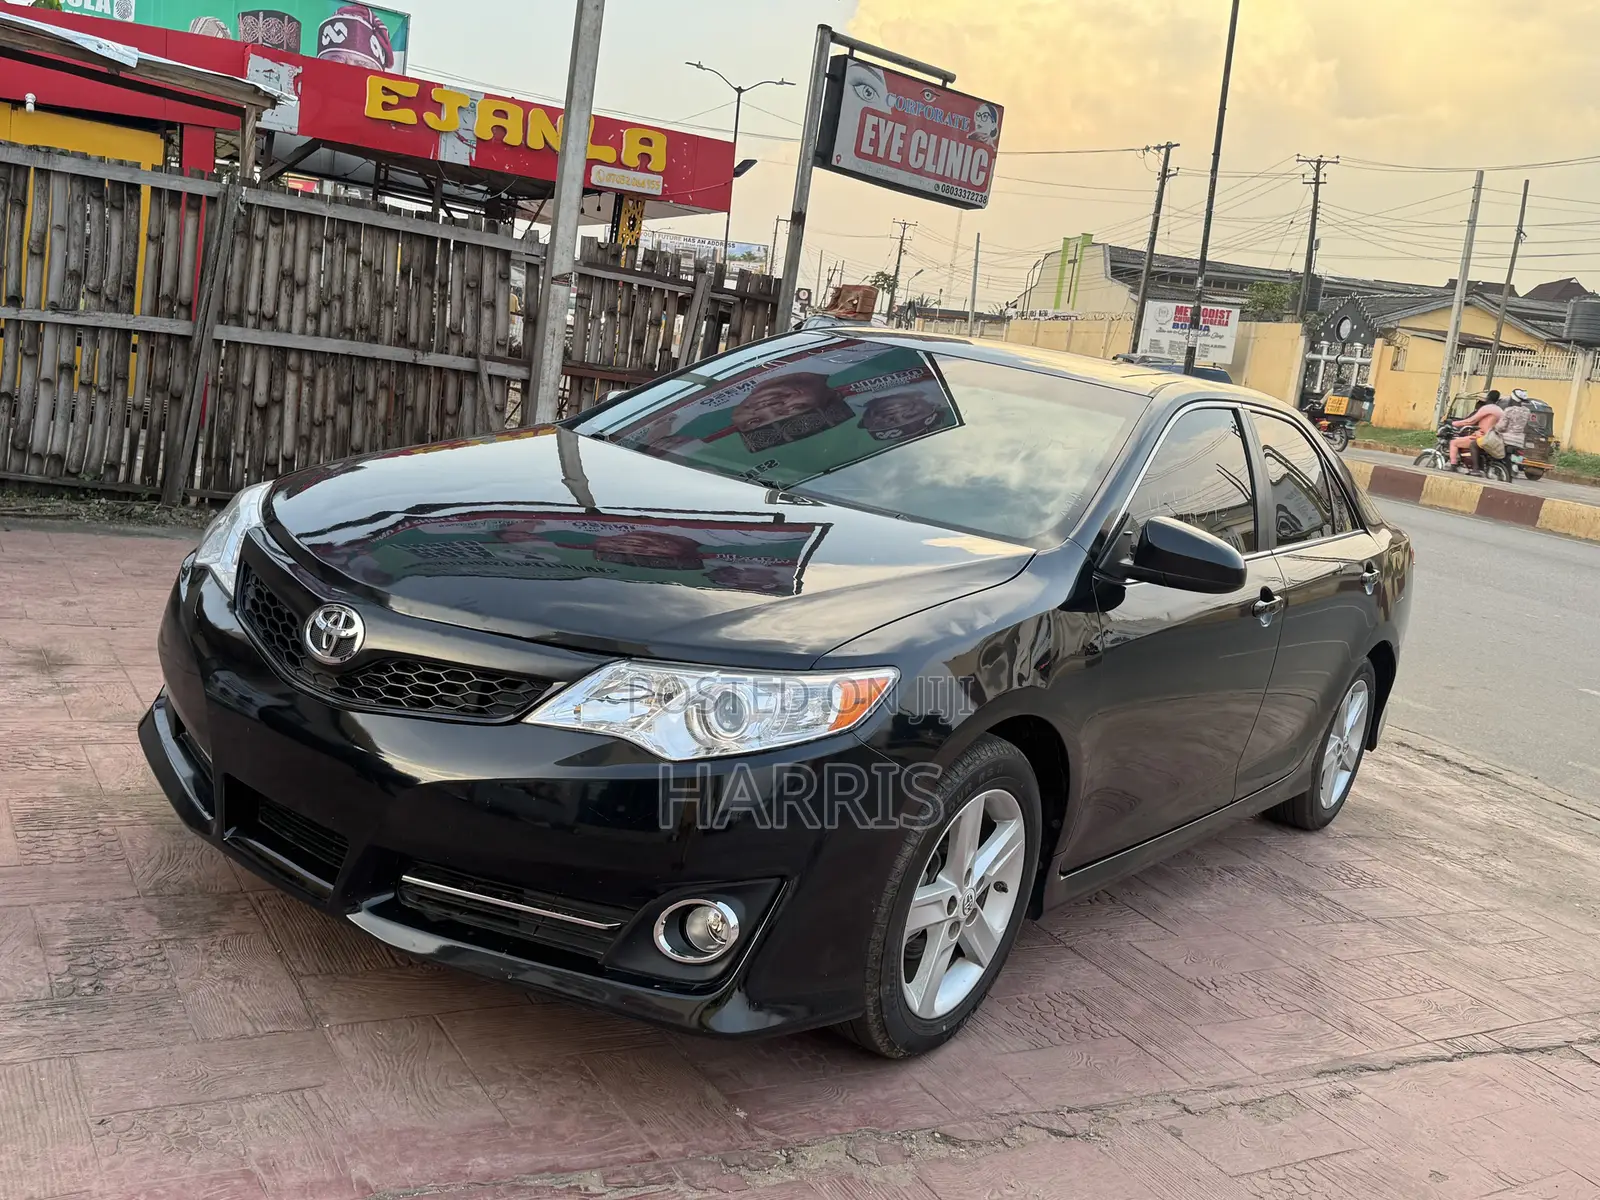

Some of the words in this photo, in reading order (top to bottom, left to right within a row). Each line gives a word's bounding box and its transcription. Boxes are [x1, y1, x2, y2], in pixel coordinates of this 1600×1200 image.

[364, 74, 668, 173] EJANLA
[885, 92, 970, 131] CORPORATE
[860, 113, 906, 163] EYE
[908, 129, 989, 187] CLINIC
[940, 183, 988, 205] 08033372738
[707, 240, 736, 249] ADDRSS
[1174, 305, 1233, 320] METODIST
